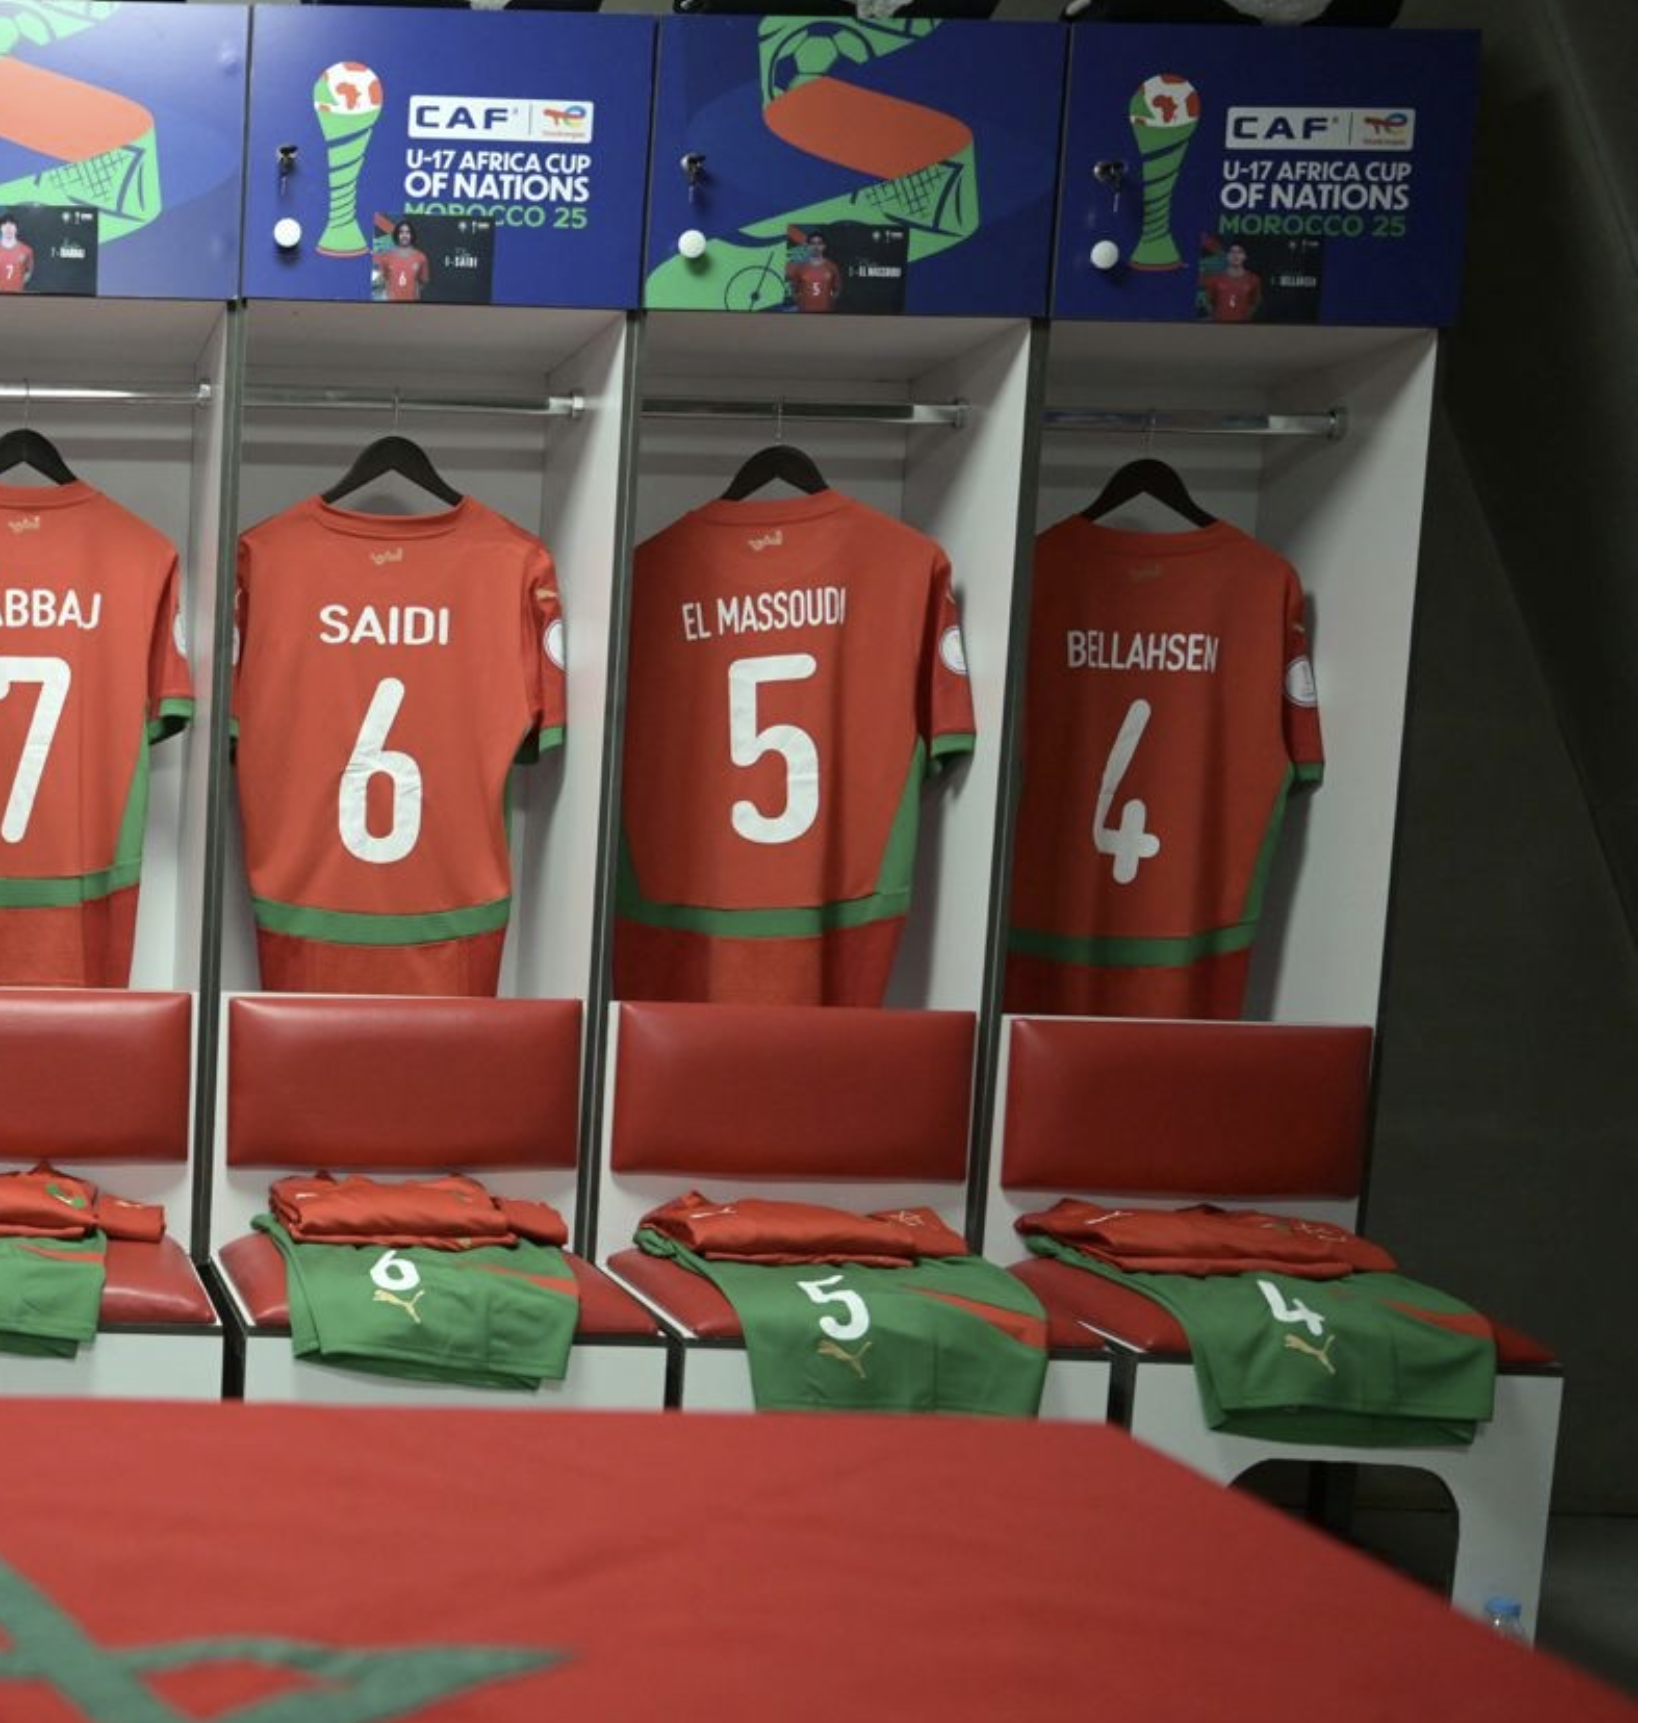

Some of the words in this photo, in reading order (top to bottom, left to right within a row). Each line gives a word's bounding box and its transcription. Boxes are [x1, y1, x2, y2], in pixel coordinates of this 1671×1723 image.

[416, 106, 508, 129] CAF
[1233, 117, 1328, 139] CAF
[406, 149, 455, 169] U-17
[459, 151, 541, 173] AFRICA
[545, 153, 591, 174] CUP
[1223, 161, 1273, 180] U-17
[1277, 161, 1361, 181] AFRICA
[1365, 162, 1412, 181] CUP
[404, 170, 448, 198] OF
[453, 172, 589, 202] NATIONS
[1221, 182, 1265, 209] OF
[1271, 183, 1409, 210] NATIONS
[553, 207, 587, 229] 25
[1219, 214, 1364, 236] MOROCCO
[1372, 216, 1406, 237] 25
[319, 604, 450, 645] SAIDI
[682, 602, 712, 641] EL
[717, 587, 846, 635] MASSOUDI
[1067, 630, 1219, 674] BELLAHSEN
[729, 653, 819, 844] 5
[339, 677, 422, 863] 6
[1093, 699, 1160, 884] 4
[370, 1249, 421, 1291] 6
[796, 1275, 870, 1341] 5
[1256, 1280, 1325, 1336] 4
